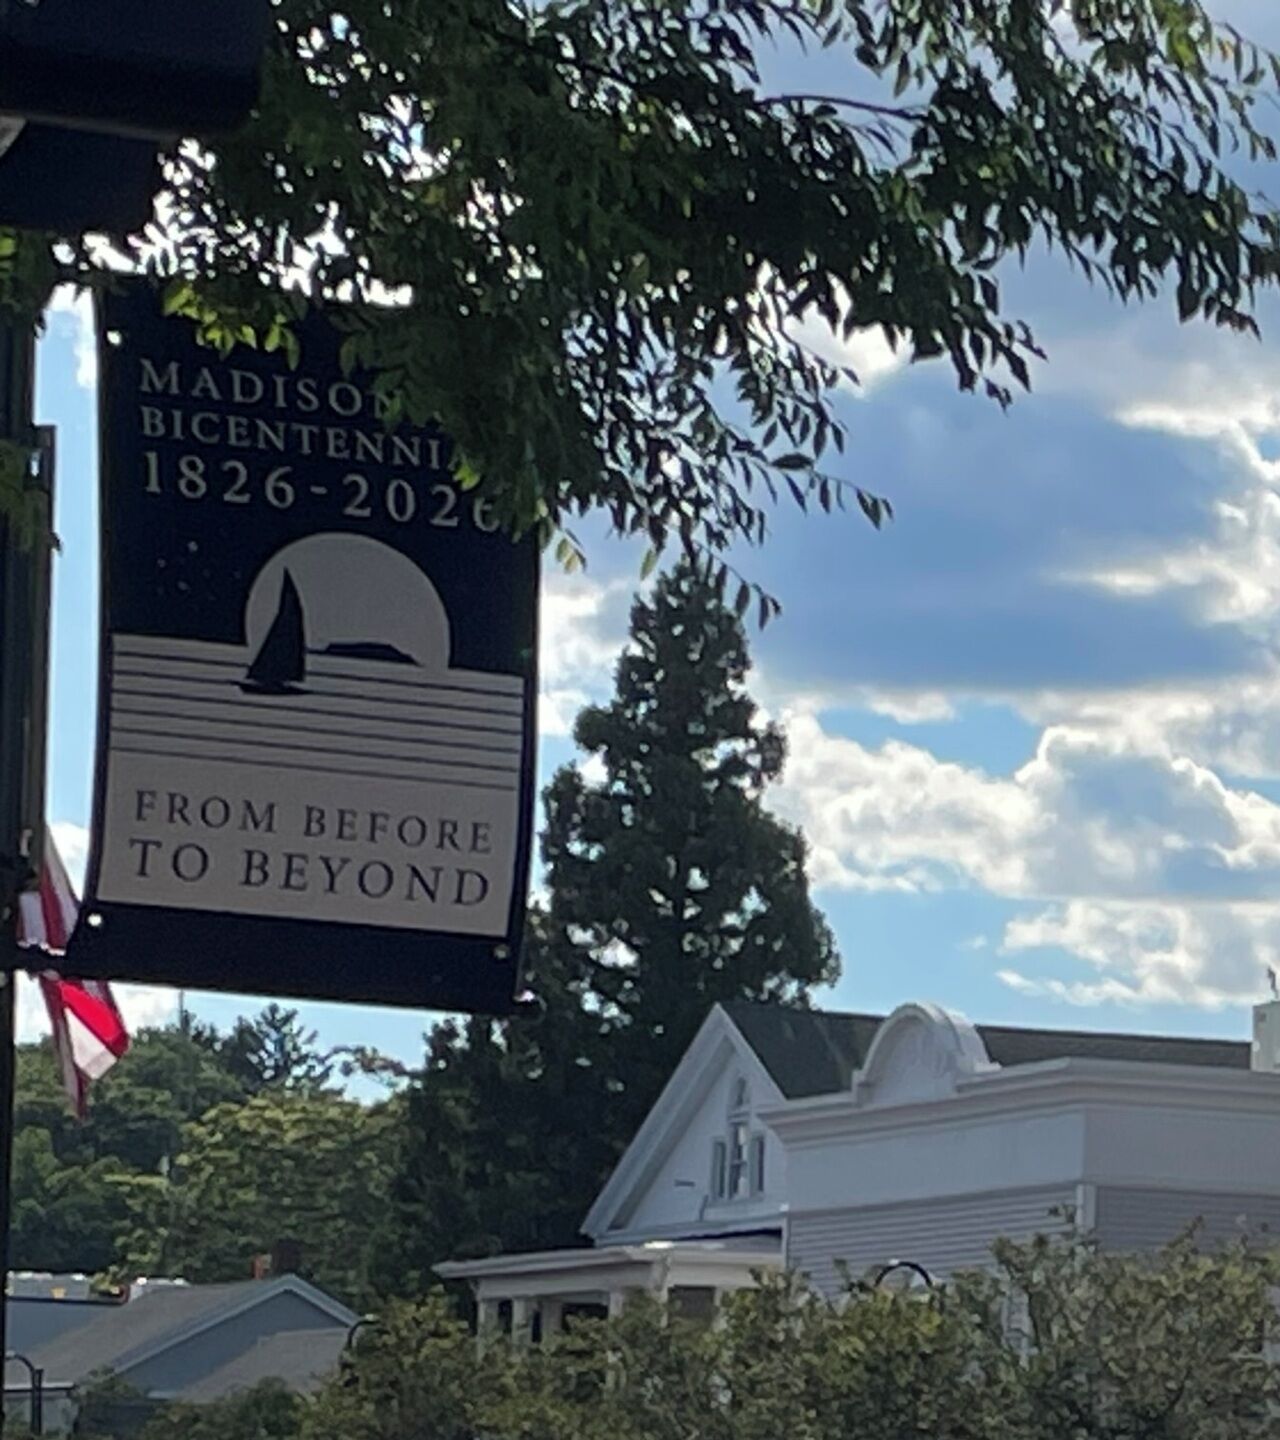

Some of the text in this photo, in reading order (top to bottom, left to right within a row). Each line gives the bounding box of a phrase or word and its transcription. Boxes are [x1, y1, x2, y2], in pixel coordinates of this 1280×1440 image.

[144, 451, 500, 533] 1826-2026
[134, 789, 492, 854] FROM BEFORE
[129, 838, 489, 906] TO BEYOND
